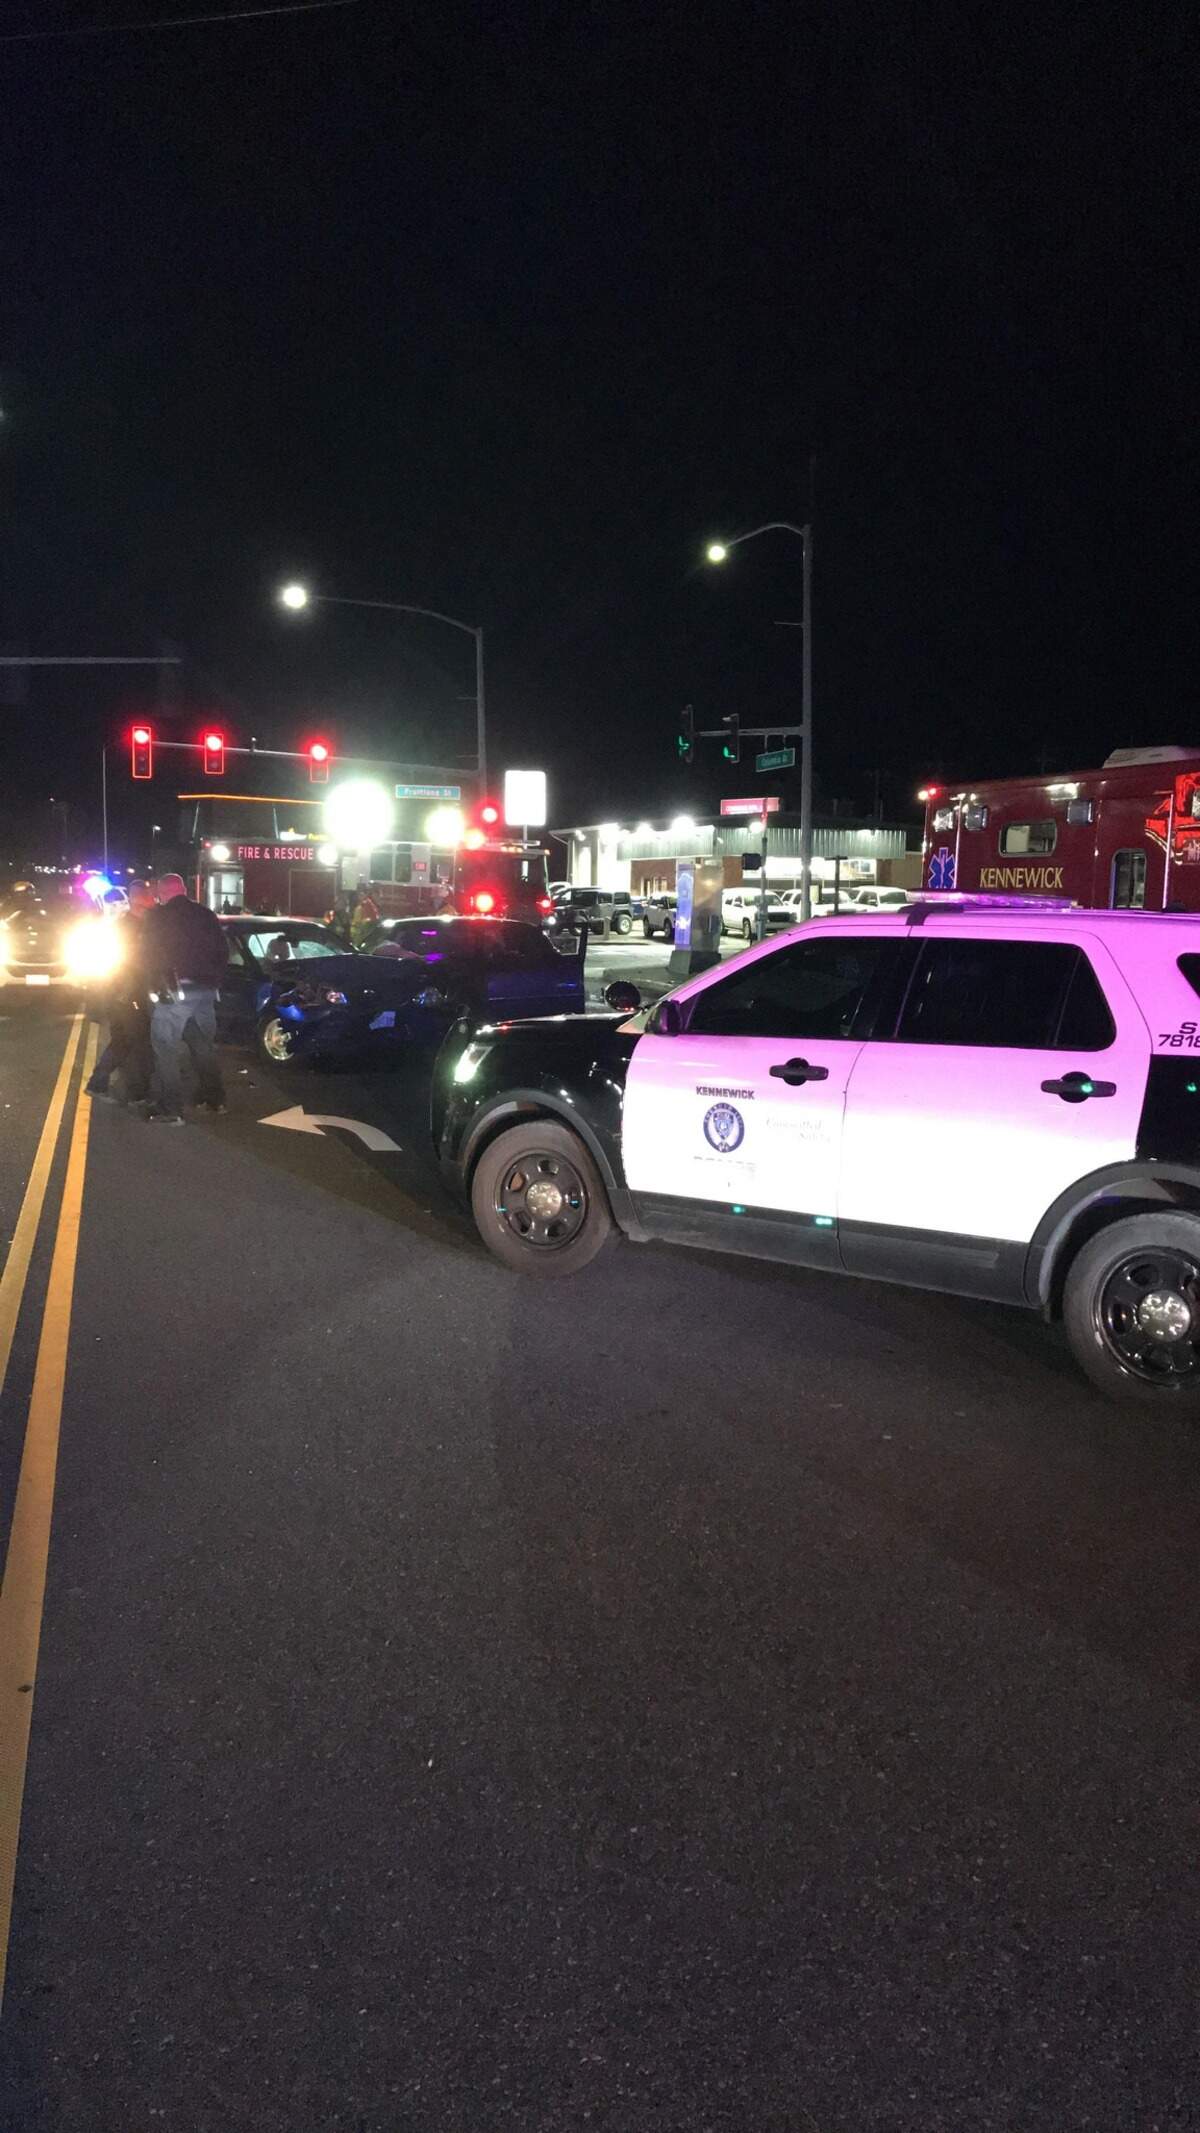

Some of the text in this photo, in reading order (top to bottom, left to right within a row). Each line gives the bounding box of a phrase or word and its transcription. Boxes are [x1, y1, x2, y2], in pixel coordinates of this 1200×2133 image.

[238, 846, 314, 860] FIRE & RESCUE
[979, 867, 1064, 889] KENNEWICK
[695, 1085, 756, 1100] KENNEWICK
